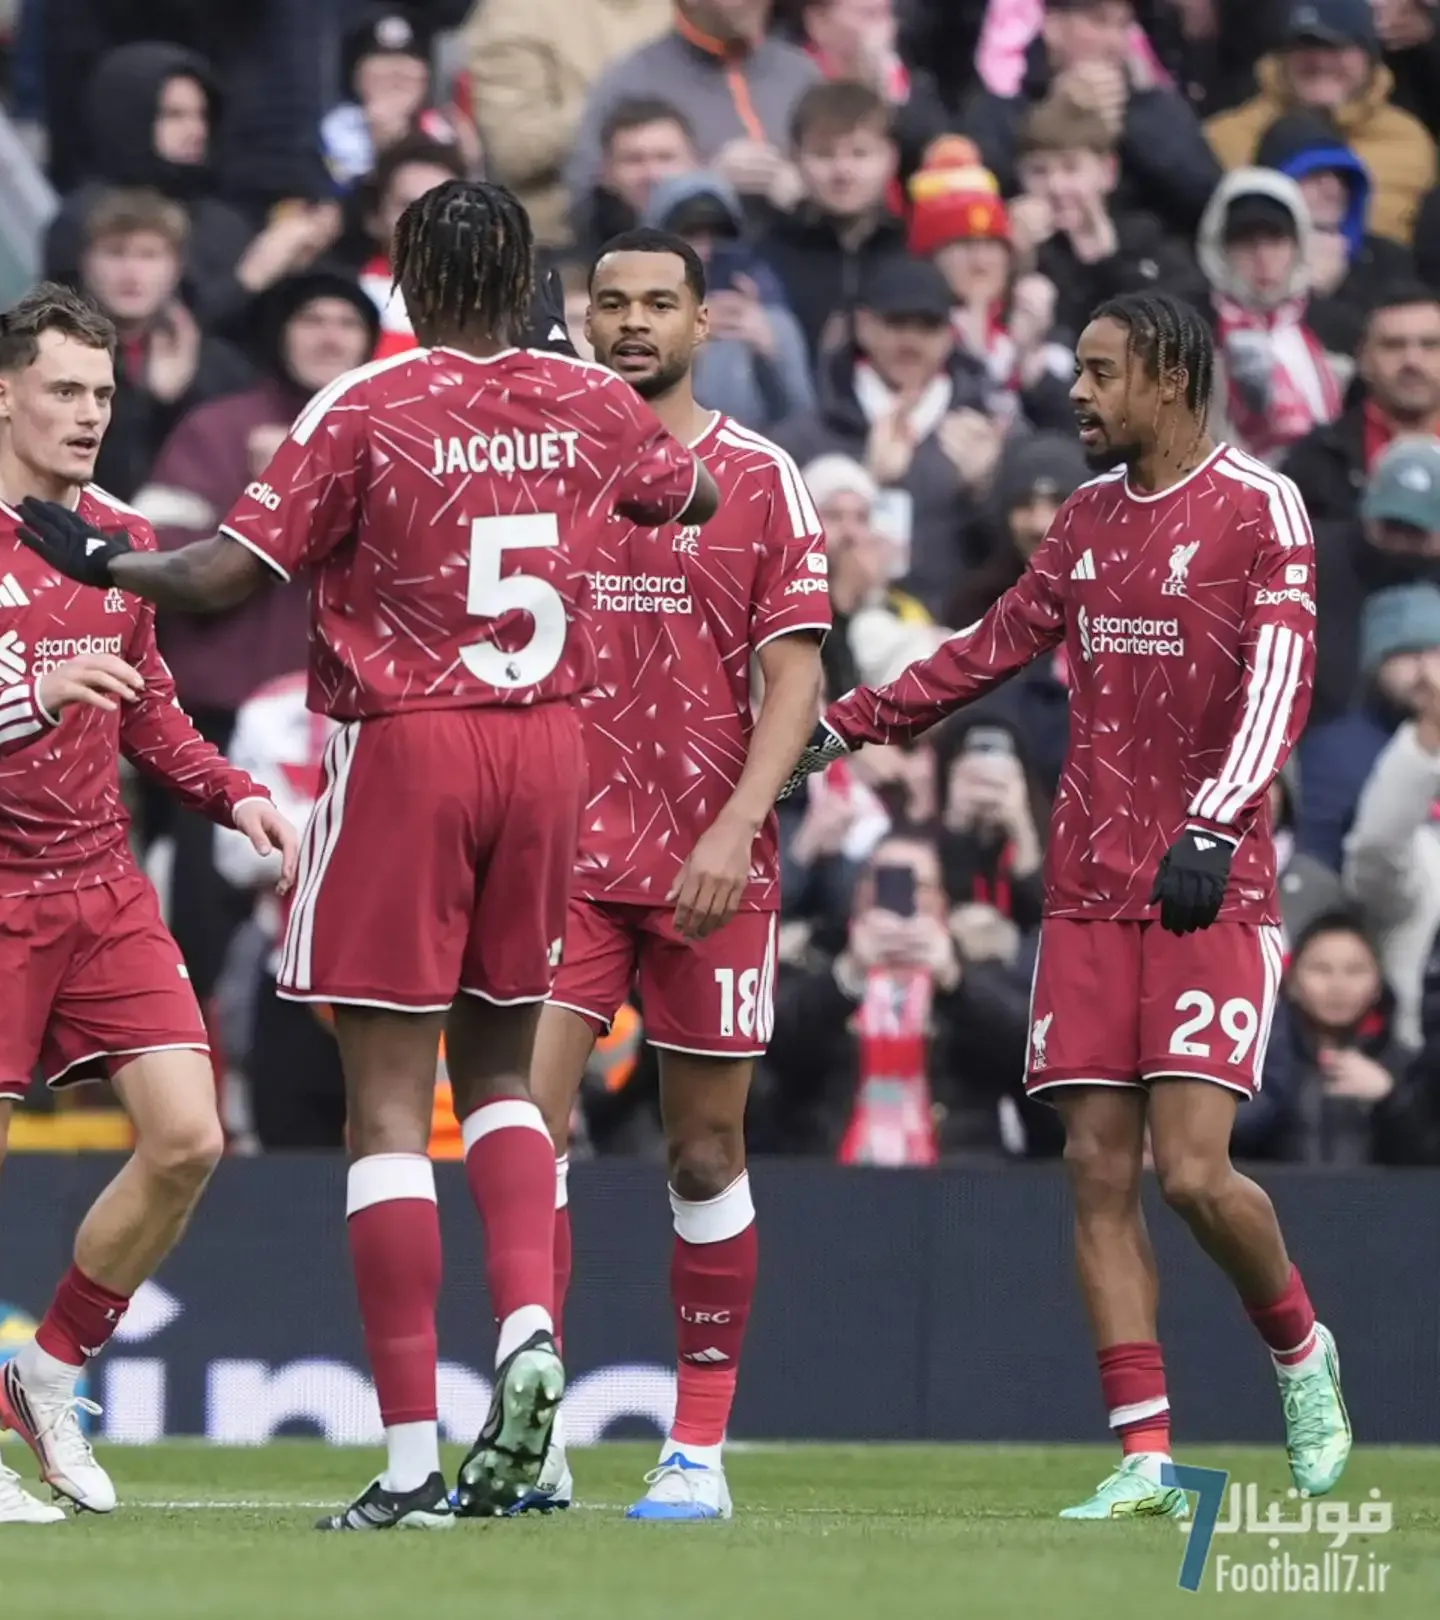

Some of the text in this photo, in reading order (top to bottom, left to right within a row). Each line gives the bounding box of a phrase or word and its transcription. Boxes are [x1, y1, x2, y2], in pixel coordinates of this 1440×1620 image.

[431, 431, 579, 477] JACQUET
[673, 538, 699, 556] LFC
[458, 512, 567, 689] 5
[1161, 584, 1188, 597] LFC
[104, 599, 127, 613] LFC
[1091, 614, 1179, 637] standard
[34, 633, 122, 657] standard
[1091, 633, 1185, 657] chartered
[715, 968, 759, 1038] 18
[1168, 989, 1259, 1065] 29
[680, 1304, 730, 1325] LFC
